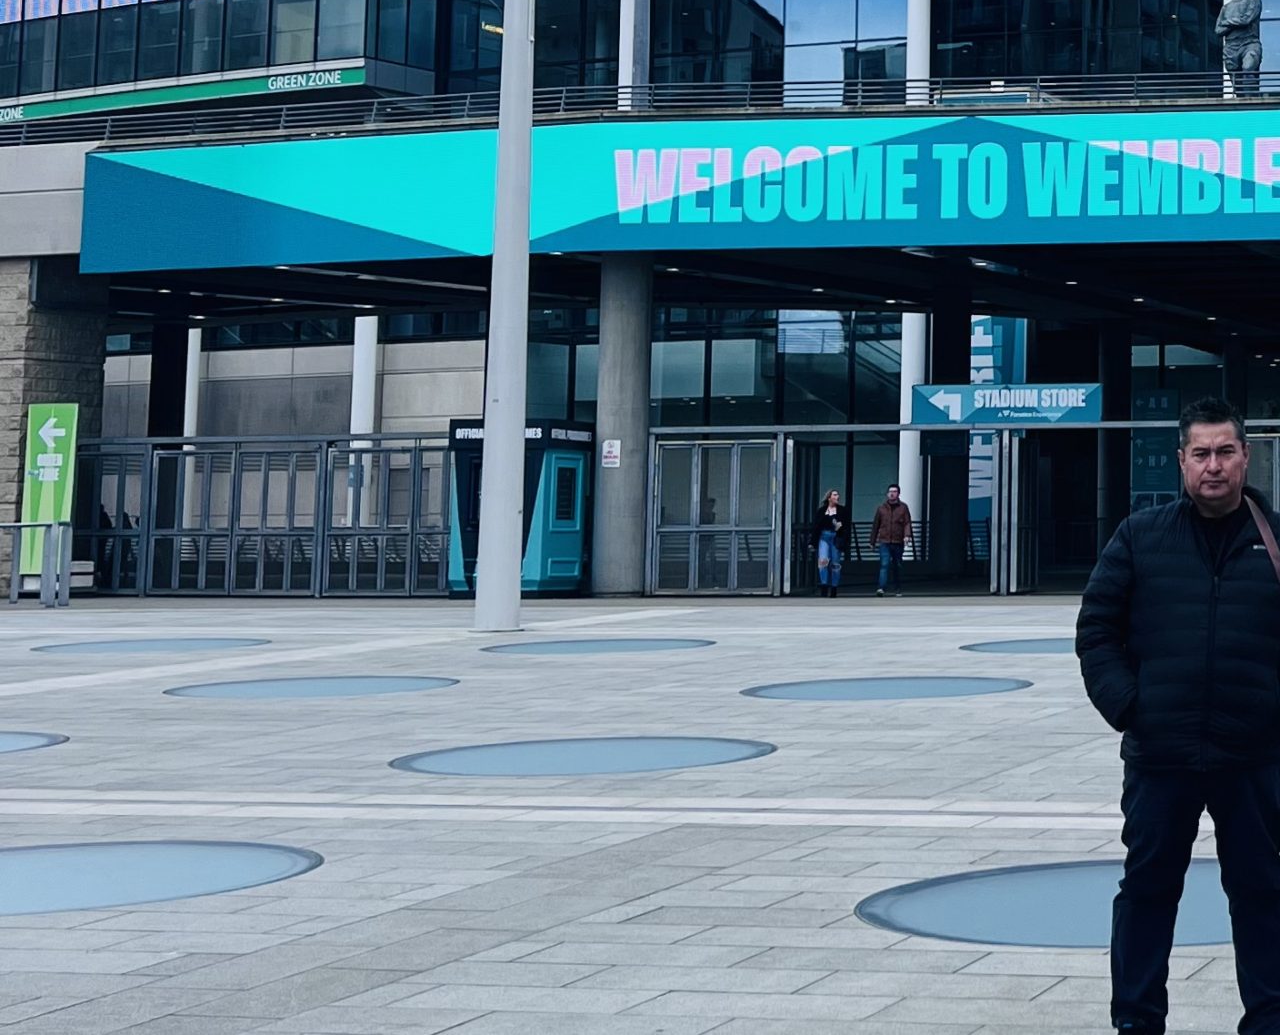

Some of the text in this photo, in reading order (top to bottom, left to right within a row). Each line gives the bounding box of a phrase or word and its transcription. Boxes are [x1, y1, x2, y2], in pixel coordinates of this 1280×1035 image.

[267, 70, 342, 90] GREEN ZONE
[614, 145, 917, 224] WELCOME
[932, 142, 1006, 219] TO
[974, 388, 1086, 408] STADIUM STORE
[455, 428, 484, 439] OFFICIA
